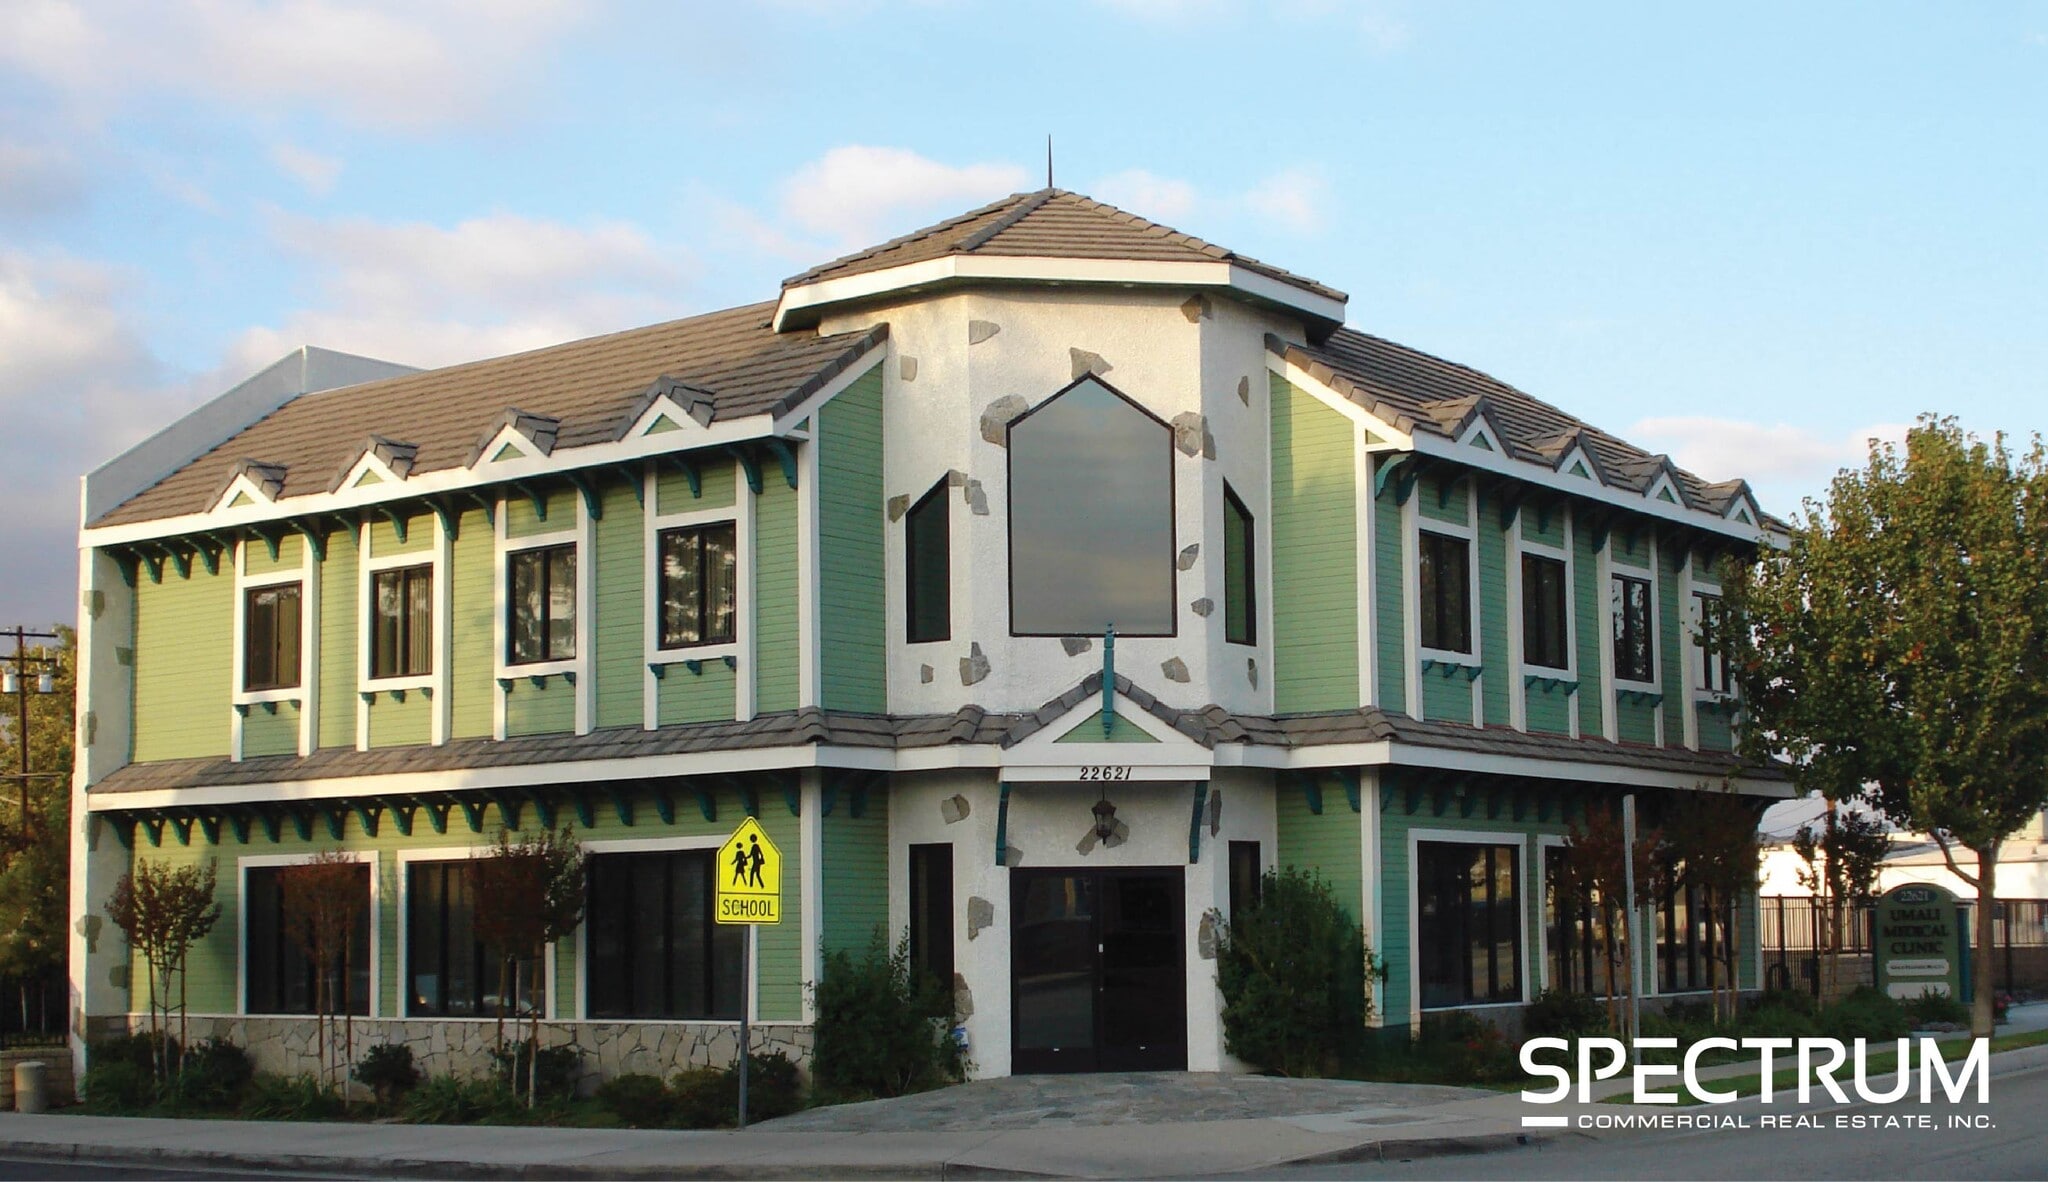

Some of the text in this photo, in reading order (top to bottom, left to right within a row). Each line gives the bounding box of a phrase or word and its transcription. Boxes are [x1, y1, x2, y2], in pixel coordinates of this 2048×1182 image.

[1080, 766, 1132, 780] 22621
[722, 898, 776, 917] SCHOOL
[1889, 908, 1941, 921] UMALI
[1883, 924, 1950, 937] MEDICAL
[1891, 941, 1945, 955] CLINIC
